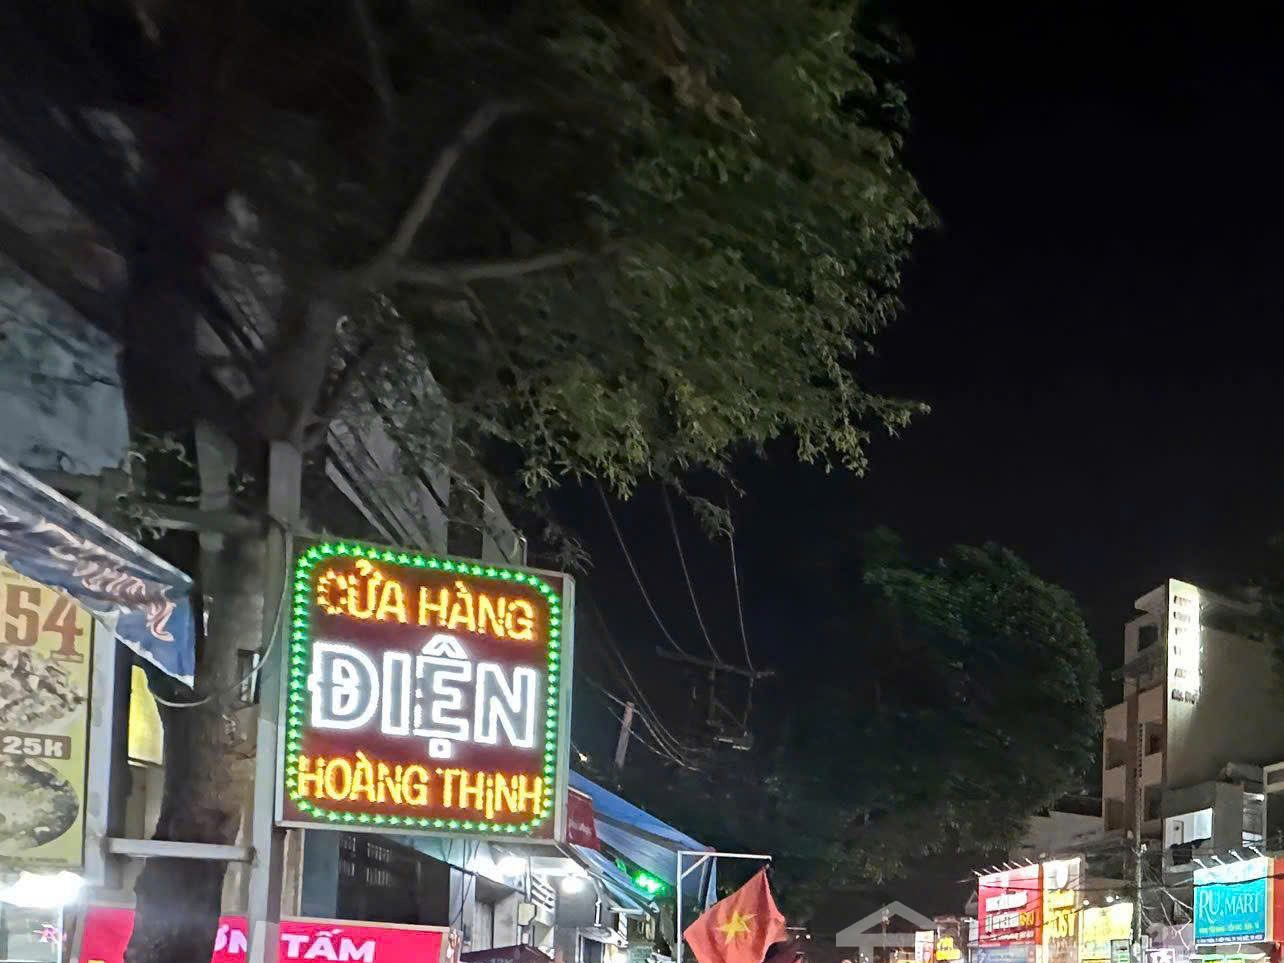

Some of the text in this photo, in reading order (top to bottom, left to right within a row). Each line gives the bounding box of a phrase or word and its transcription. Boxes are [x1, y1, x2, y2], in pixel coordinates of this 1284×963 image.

[317, 559, 536, 641] CỬA HÀNG
[308, 634, 538, 759] ĐIỆN
[3, 735, 63, 758] 25K
[298, 751, 543, 820] HOÀNG THỊNH
[281, 928, 376, 963] TẤM
